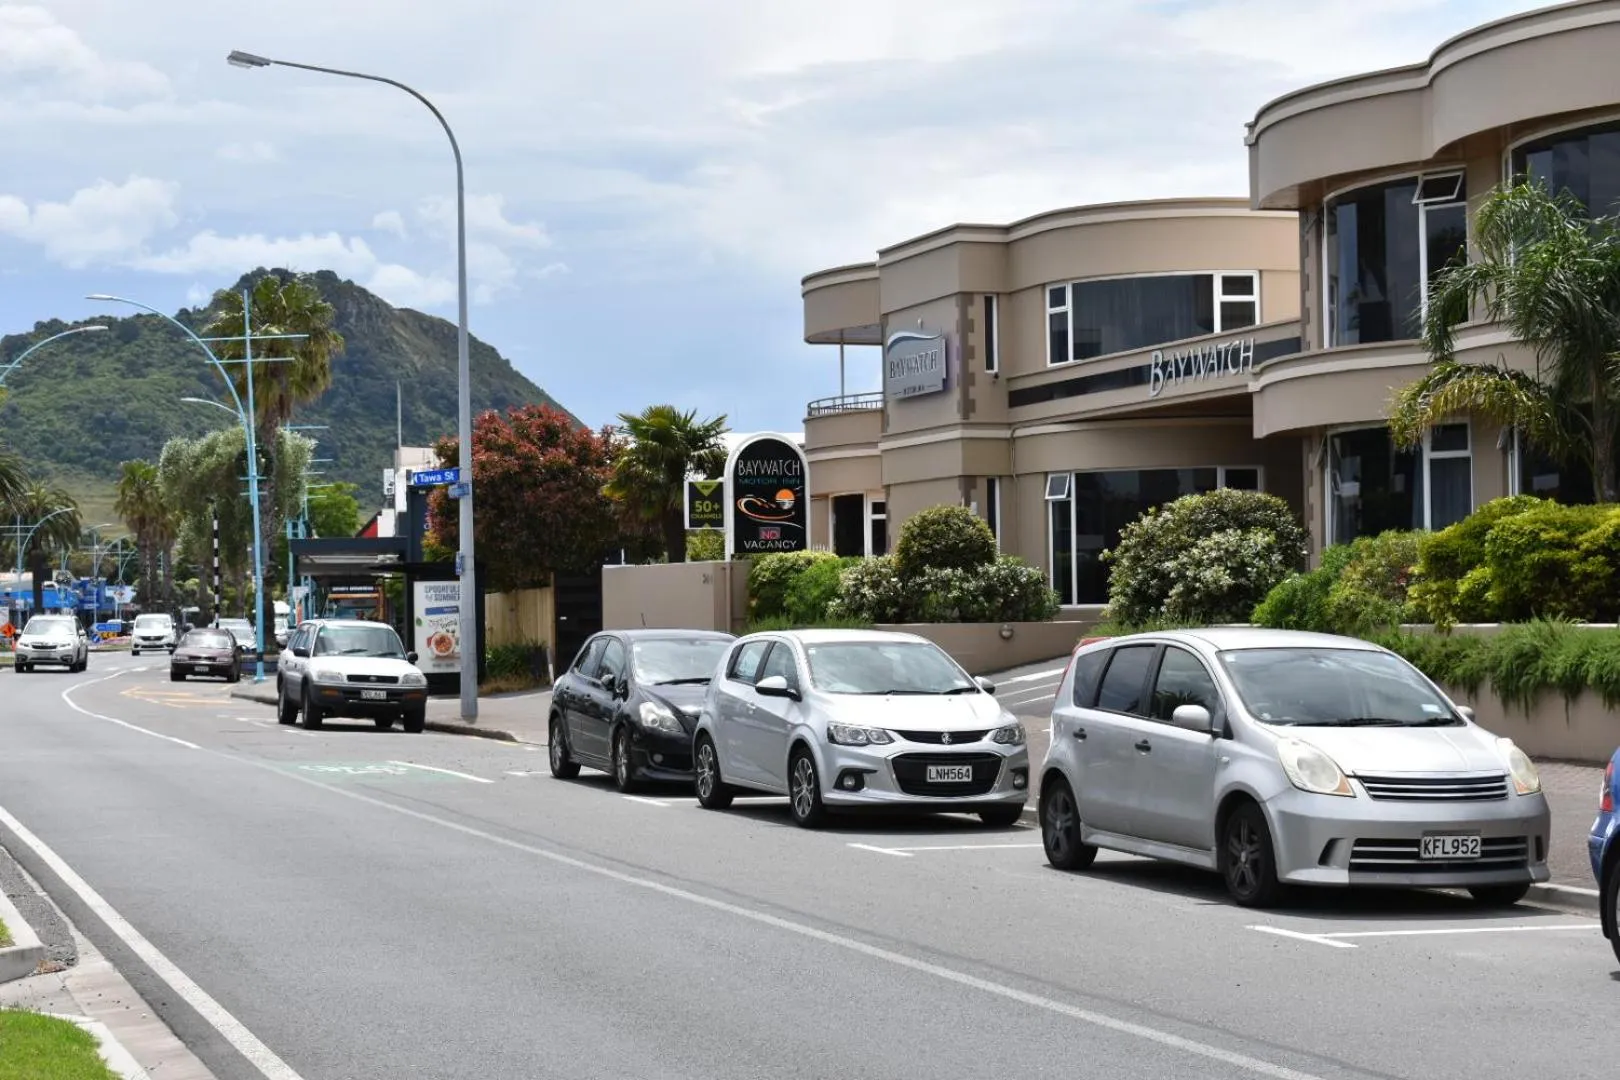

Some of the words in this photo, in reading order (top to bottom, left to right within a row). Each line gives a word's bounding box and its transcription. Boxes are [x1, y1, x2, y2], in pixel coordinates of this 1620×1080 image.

[889, 350, 938, 379] BAYWATCH
[1148, 337, 1256, 398] BAYWATCH
[738, 460, 800, 476] BAYWATCH
[418, 474, 442, 483] Tawa
[444, 471, 454, 481] St
[695, 500, 720, 513] 50+
[761, 529, 778, 540] NO
[743, 540, 797, 549] VACANCY
[928, 767, 971, 780] LNH564
[1423, 838, 1479, 855] KFL952
